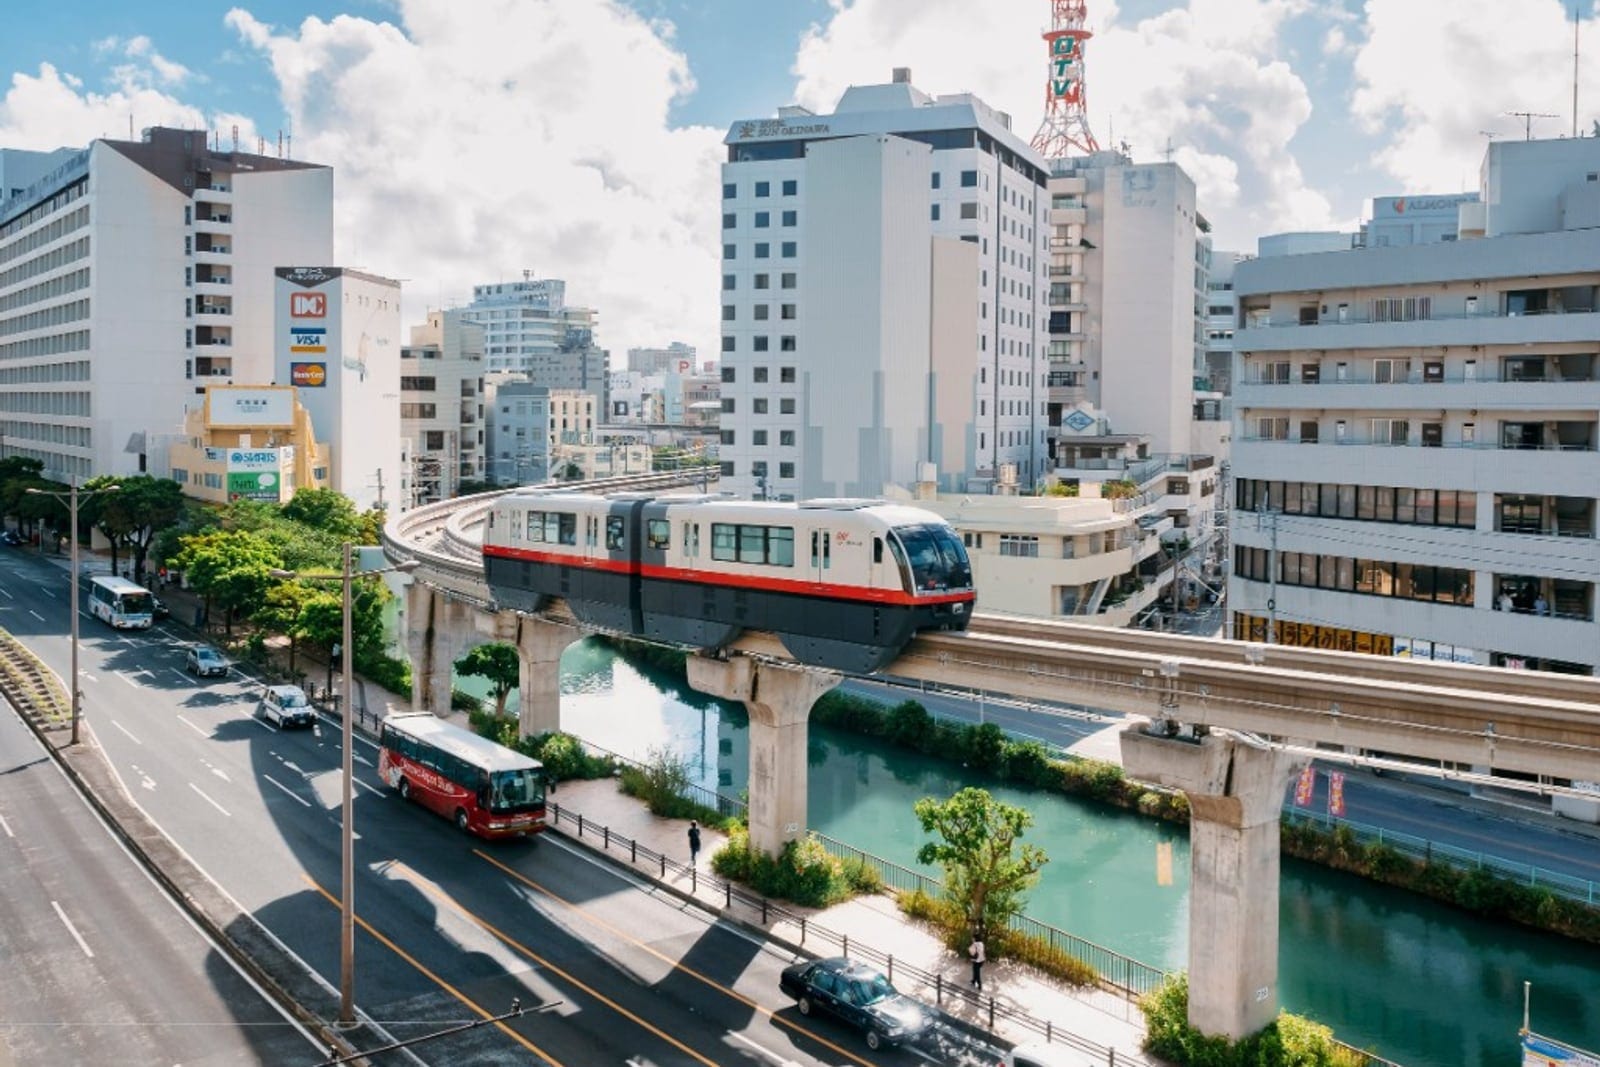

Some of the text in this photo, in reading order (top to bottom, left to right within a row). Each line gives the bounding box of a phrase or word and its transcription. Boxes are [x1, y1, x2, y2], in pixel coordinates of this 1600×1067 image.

[1053, 36, 1075, 96] OTV
[758, 124, 830, 137] SUN OKINAWA
[296, 335, 320, 345] VISA
[679, 360, 689, 374] P
